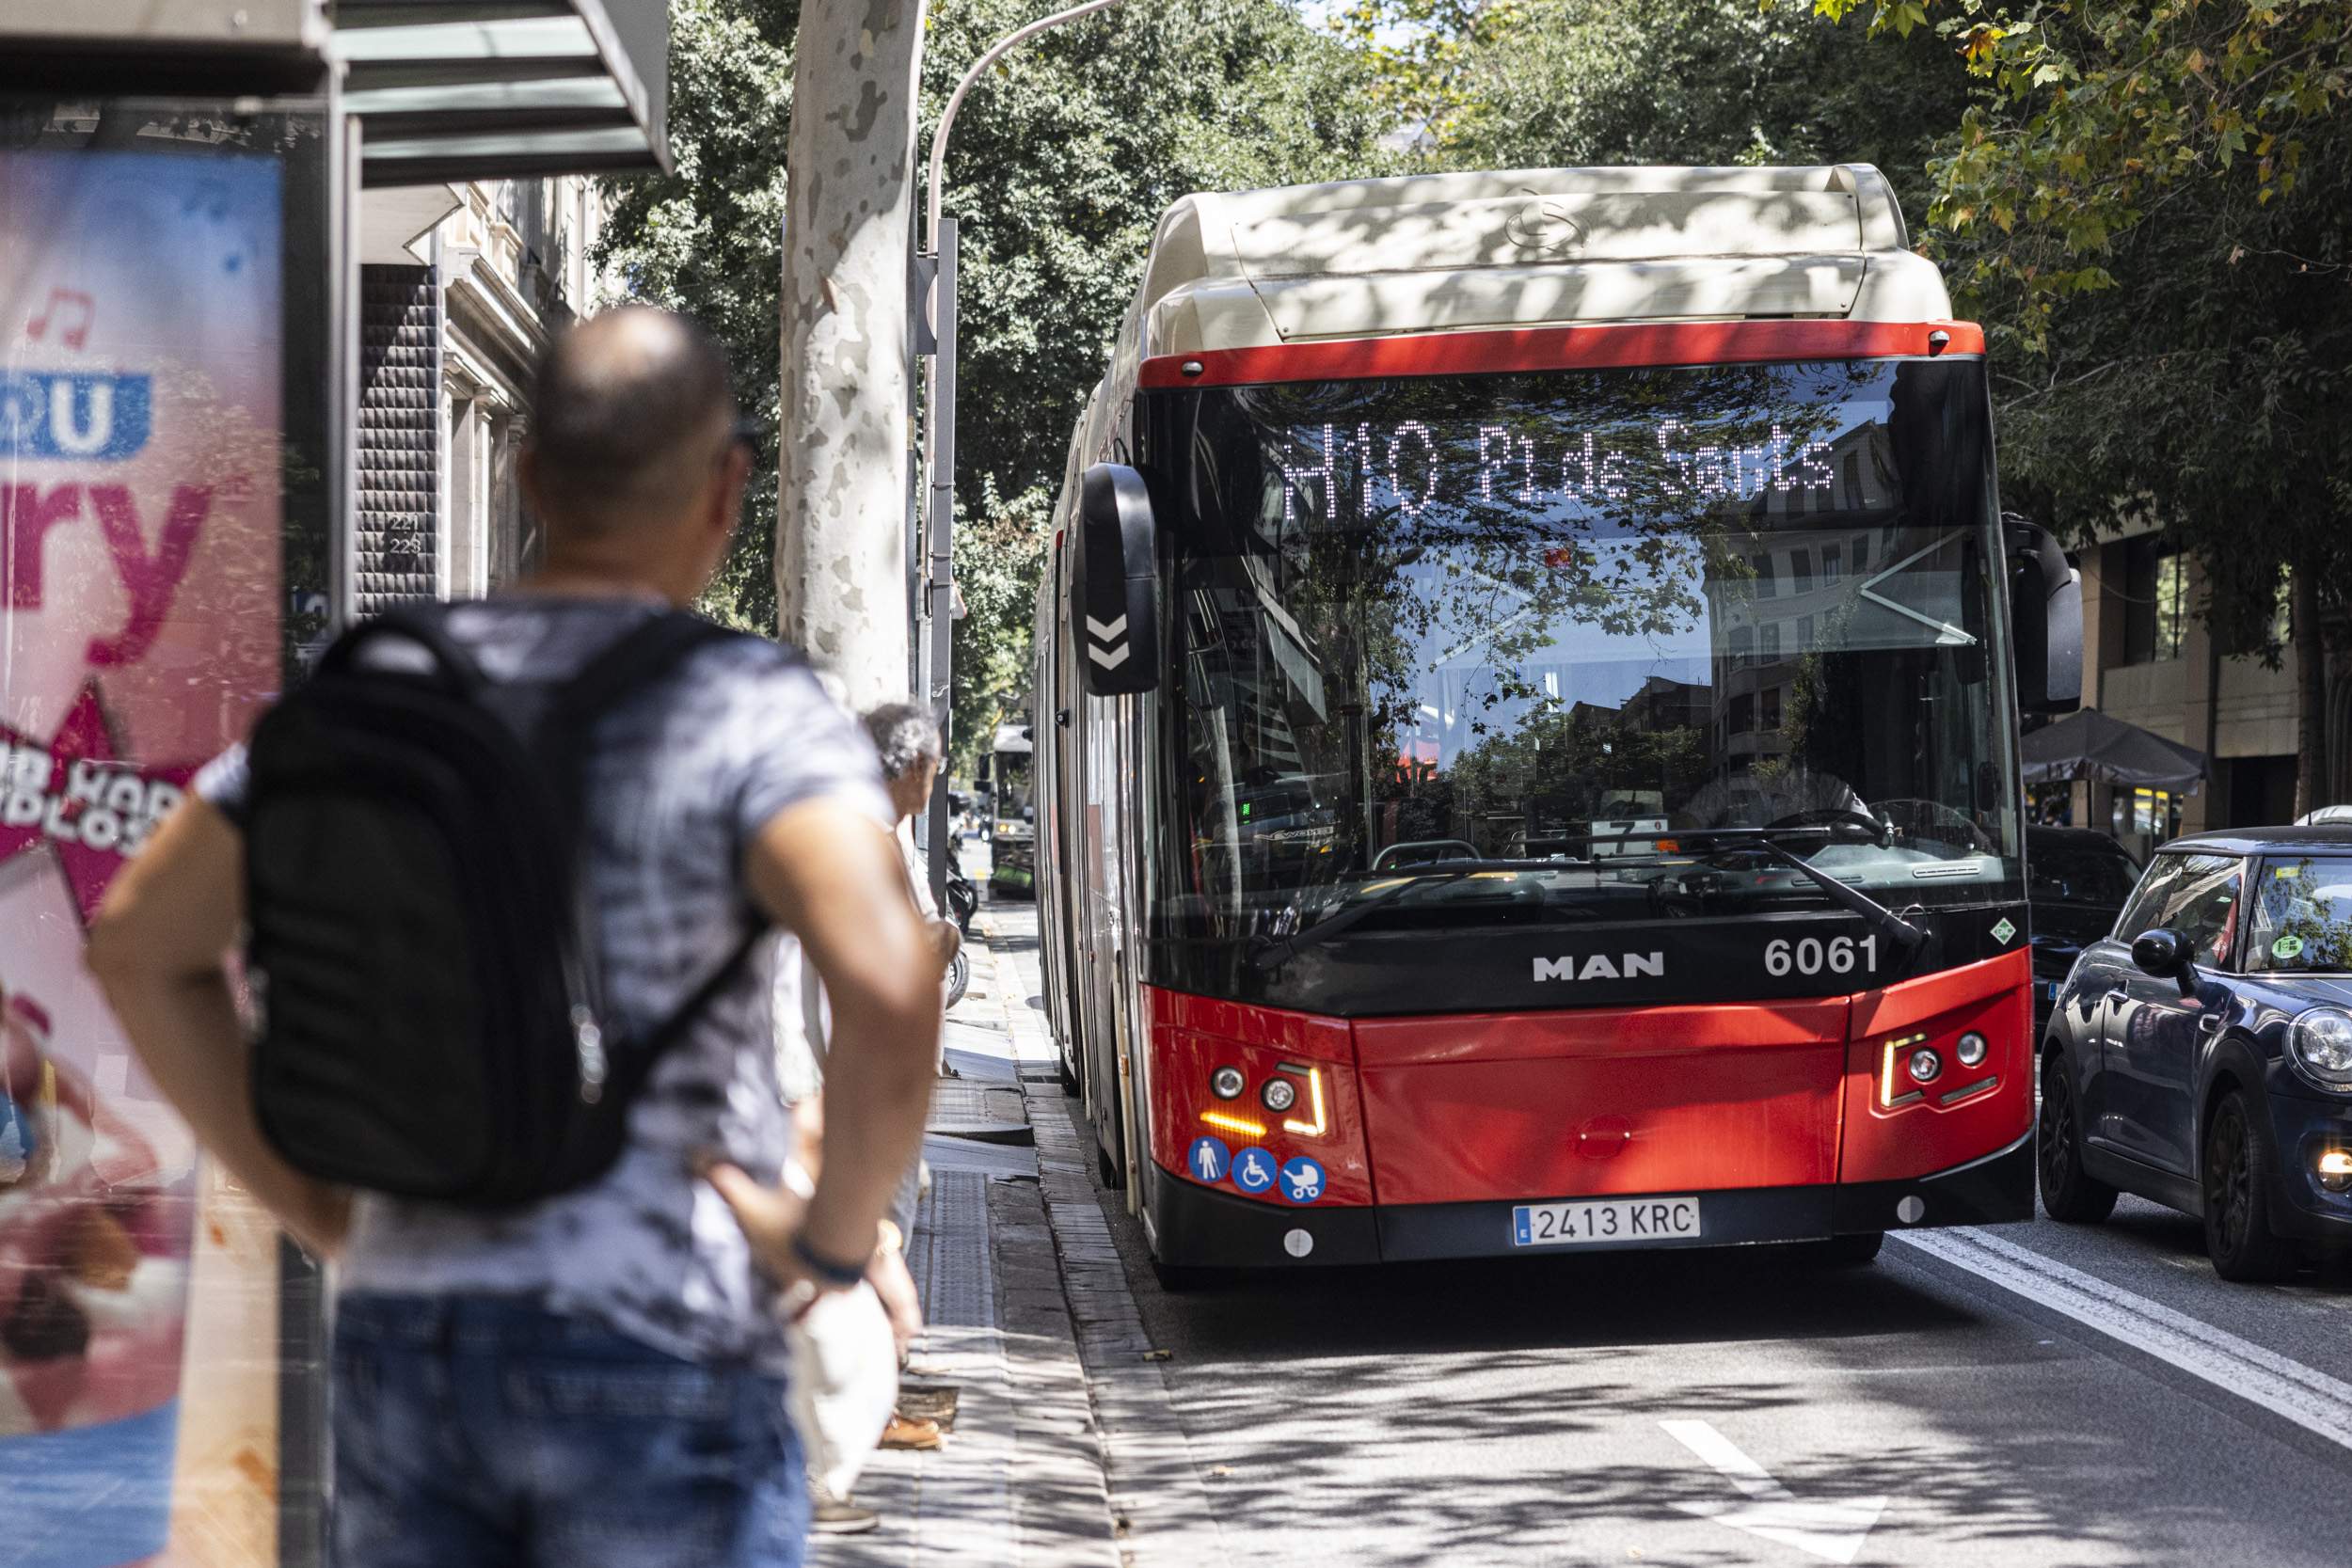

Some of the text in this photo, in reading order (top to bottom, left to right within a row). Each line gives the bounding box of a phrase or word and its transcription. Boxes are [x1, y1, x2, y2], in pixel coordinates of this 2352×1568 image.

[1284, 420, 1438, 519] H10
[1563, 433, 1630, 499] de
[1659, 420, 1835, 496] Sants
[390, 514, 419, 531] 221
[389, 537, 421, 554] 223
[1533, 952, 1664, 982] MAN
[1764, 934, 1877, 977] 6061
[1538, 1207, 1618, 1239] 2413
[1630, 1203, 1692, 1234] KRC
